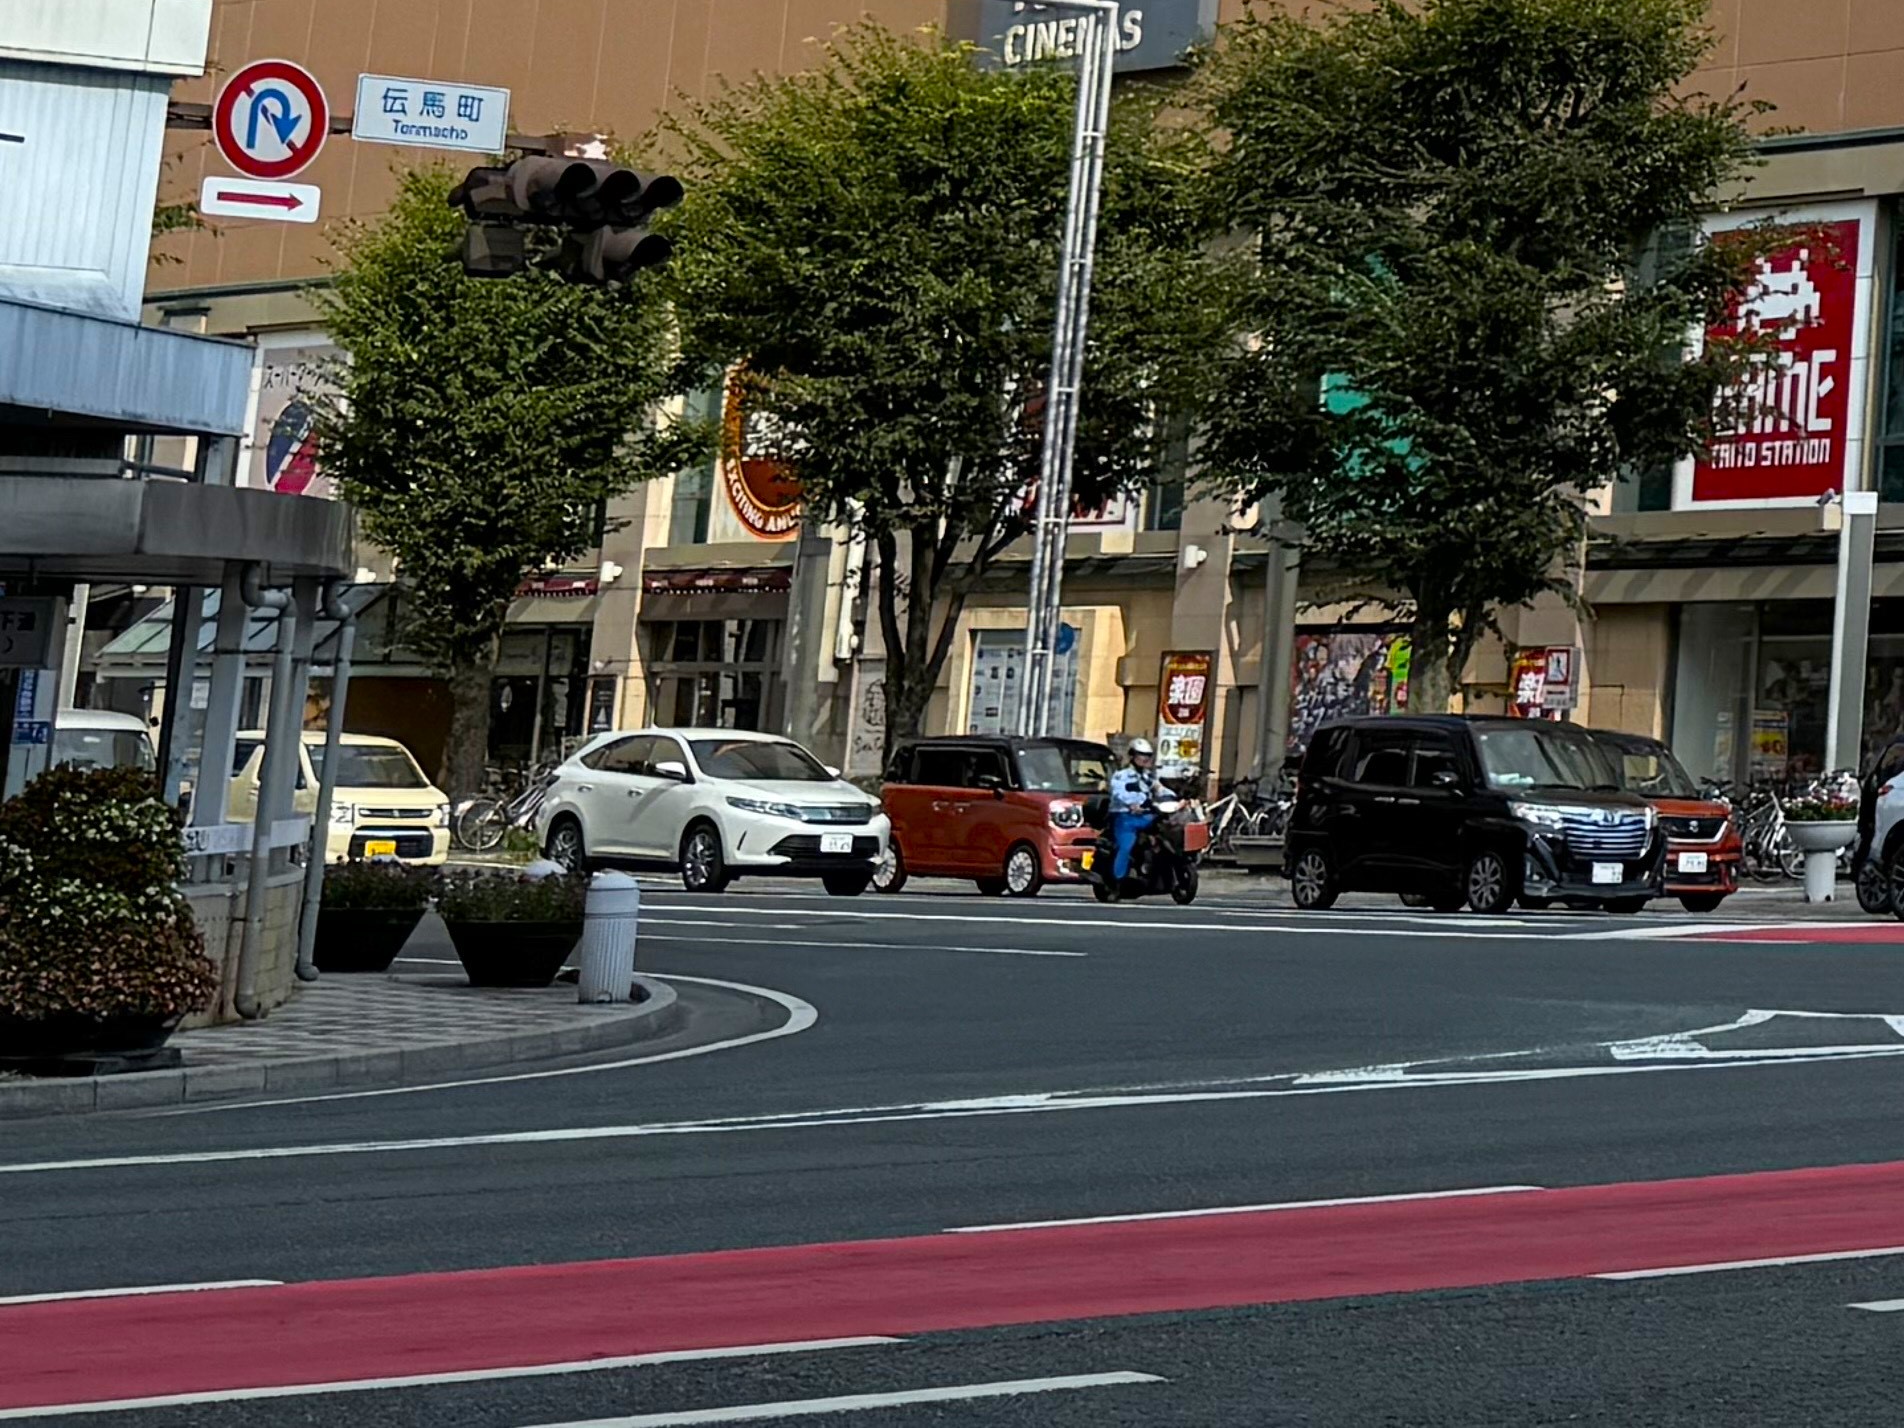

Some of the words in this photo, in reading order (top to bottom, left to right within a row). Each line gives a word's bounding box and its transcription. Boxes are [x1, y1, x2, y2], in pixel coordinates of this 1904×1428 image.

[382, 87, 484, 122] 伝馬町
[1760, 439, 1831, 466] STATION
